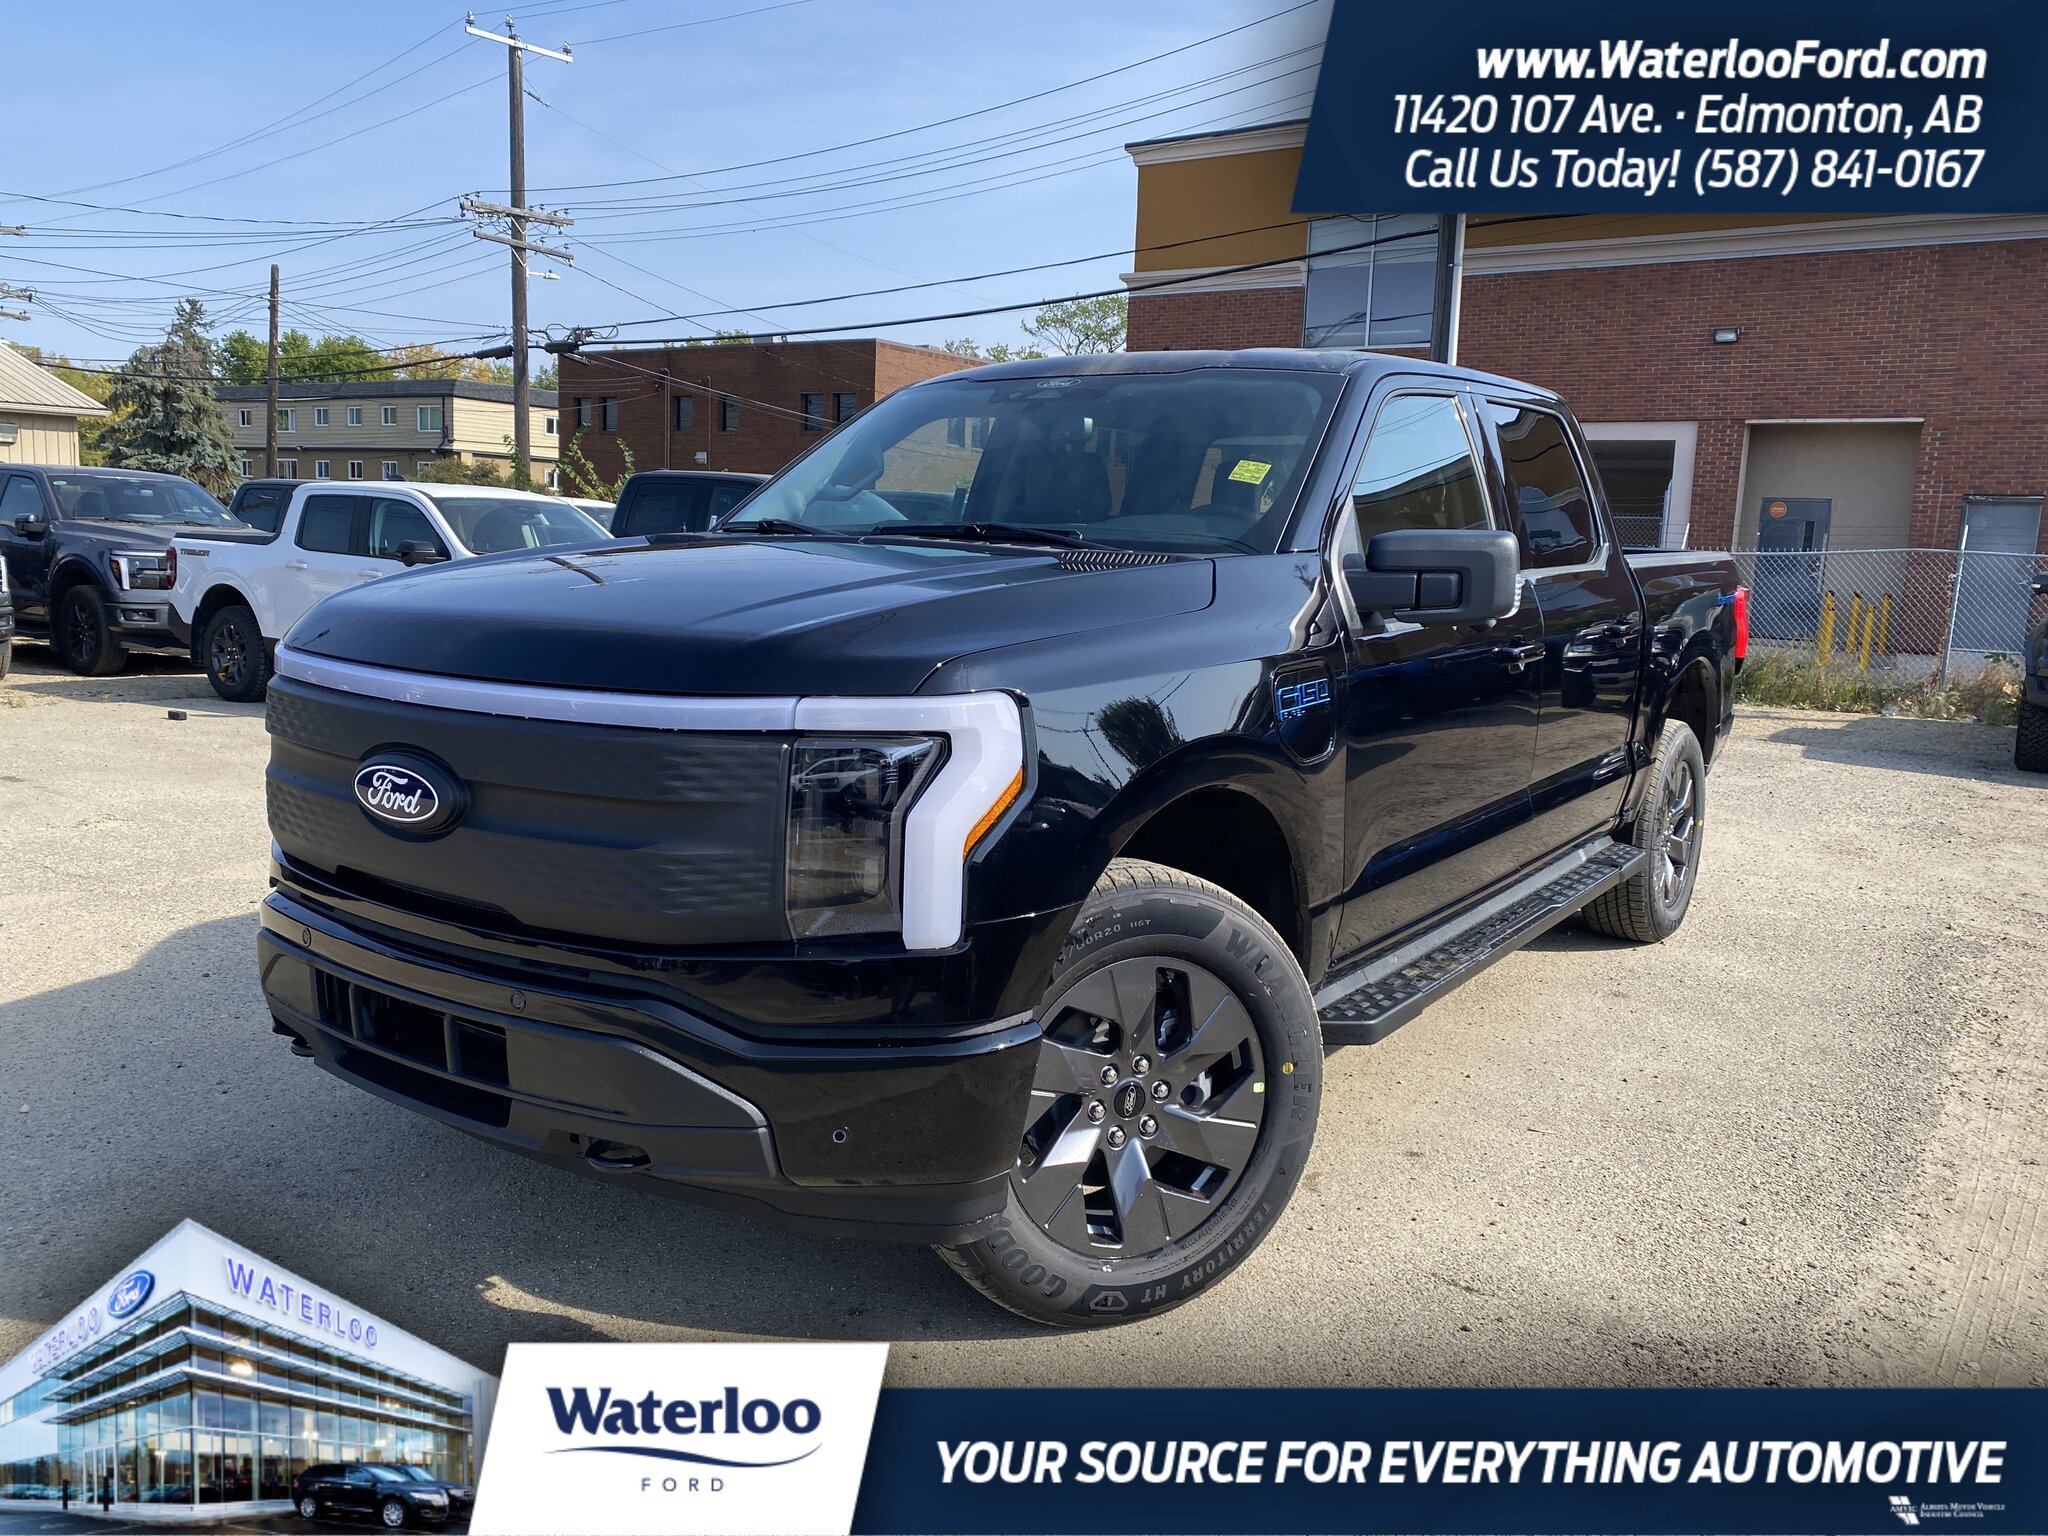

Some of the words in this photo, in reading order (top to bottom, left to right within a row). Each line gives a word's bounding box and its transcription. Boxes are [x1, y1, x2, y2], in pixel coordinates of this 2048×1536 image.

[367, 771, 422, 815] Ford
[987, 1229, 1068, 1298] GOOD
[1181, 1202, 1271, 1291] TERRITORY
[1141, 1284, 1167, 1304] HT
